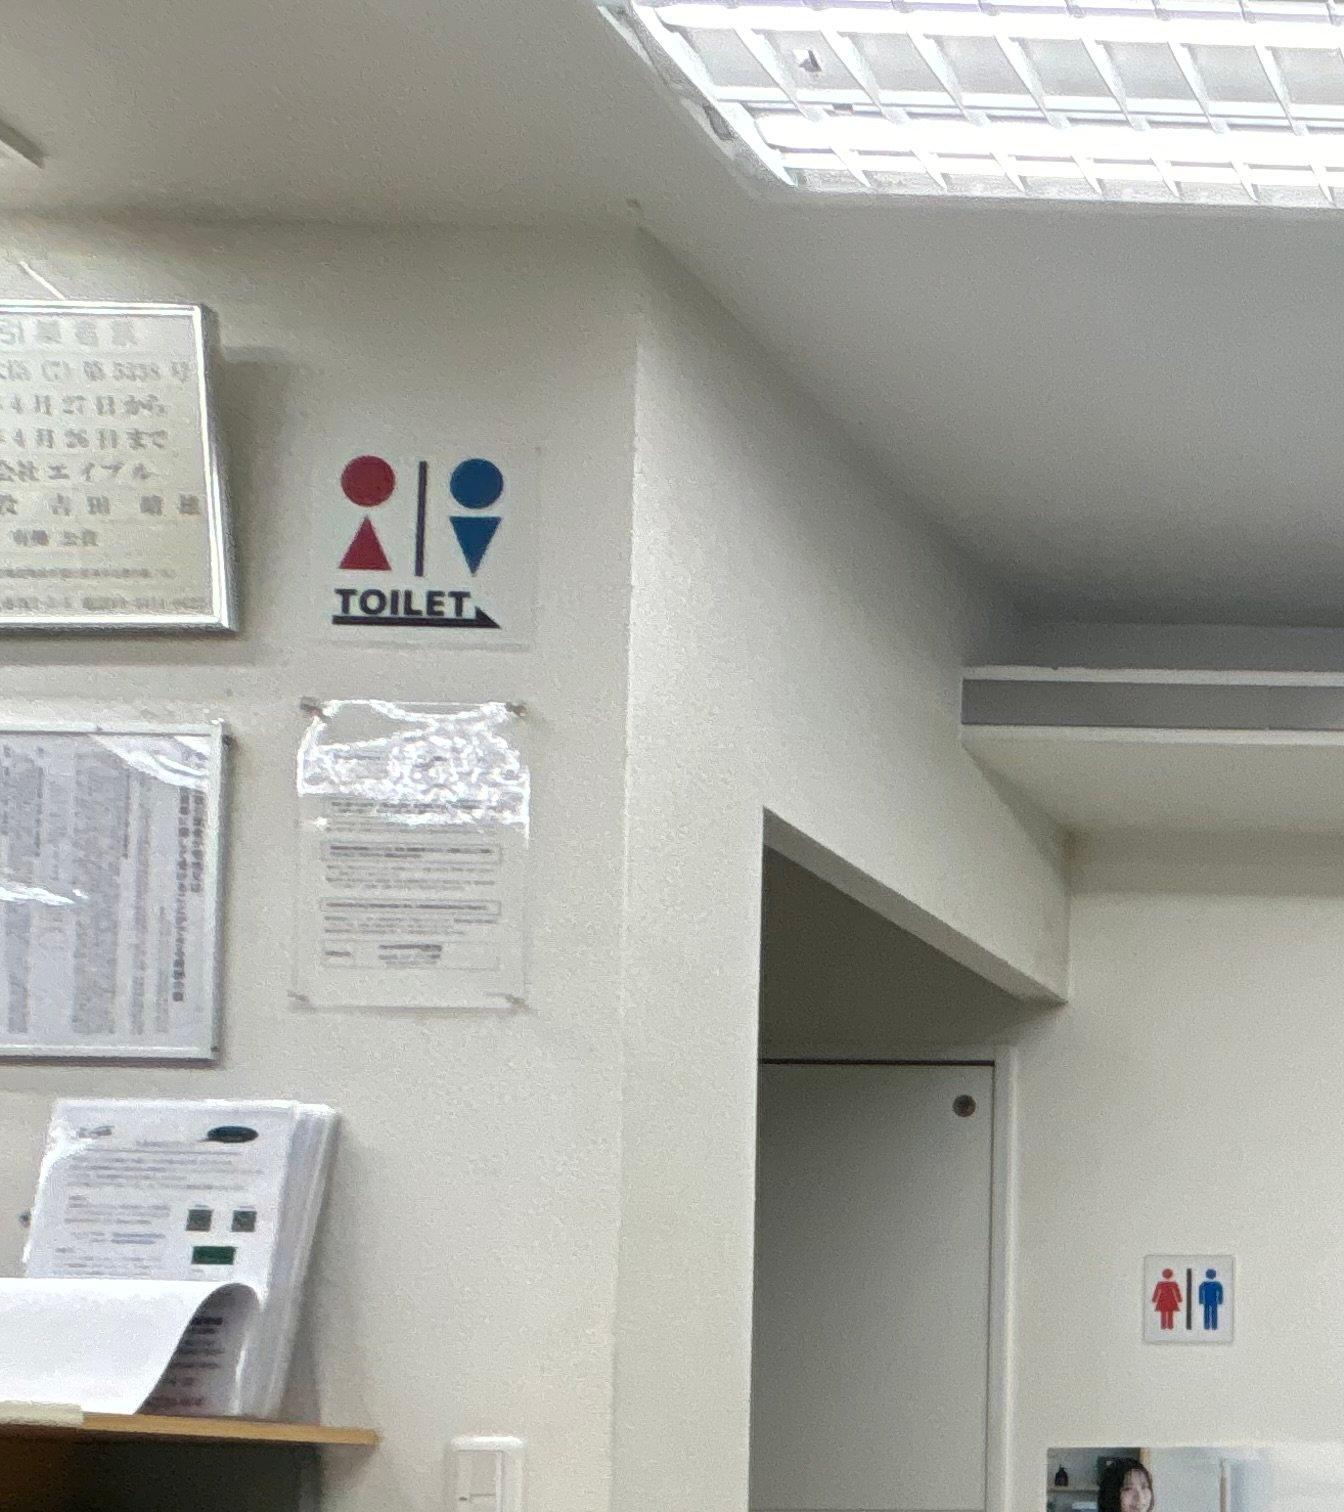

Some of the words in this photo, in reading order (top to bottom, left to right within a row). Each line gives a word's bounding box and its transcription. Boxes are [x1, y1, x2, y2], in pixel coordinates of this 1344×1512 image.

[0, 394, 168, 417] 4月27日から
[0, 428, 169, 450] 4月26日まで
[335, 588, 471, 617] TOILET
